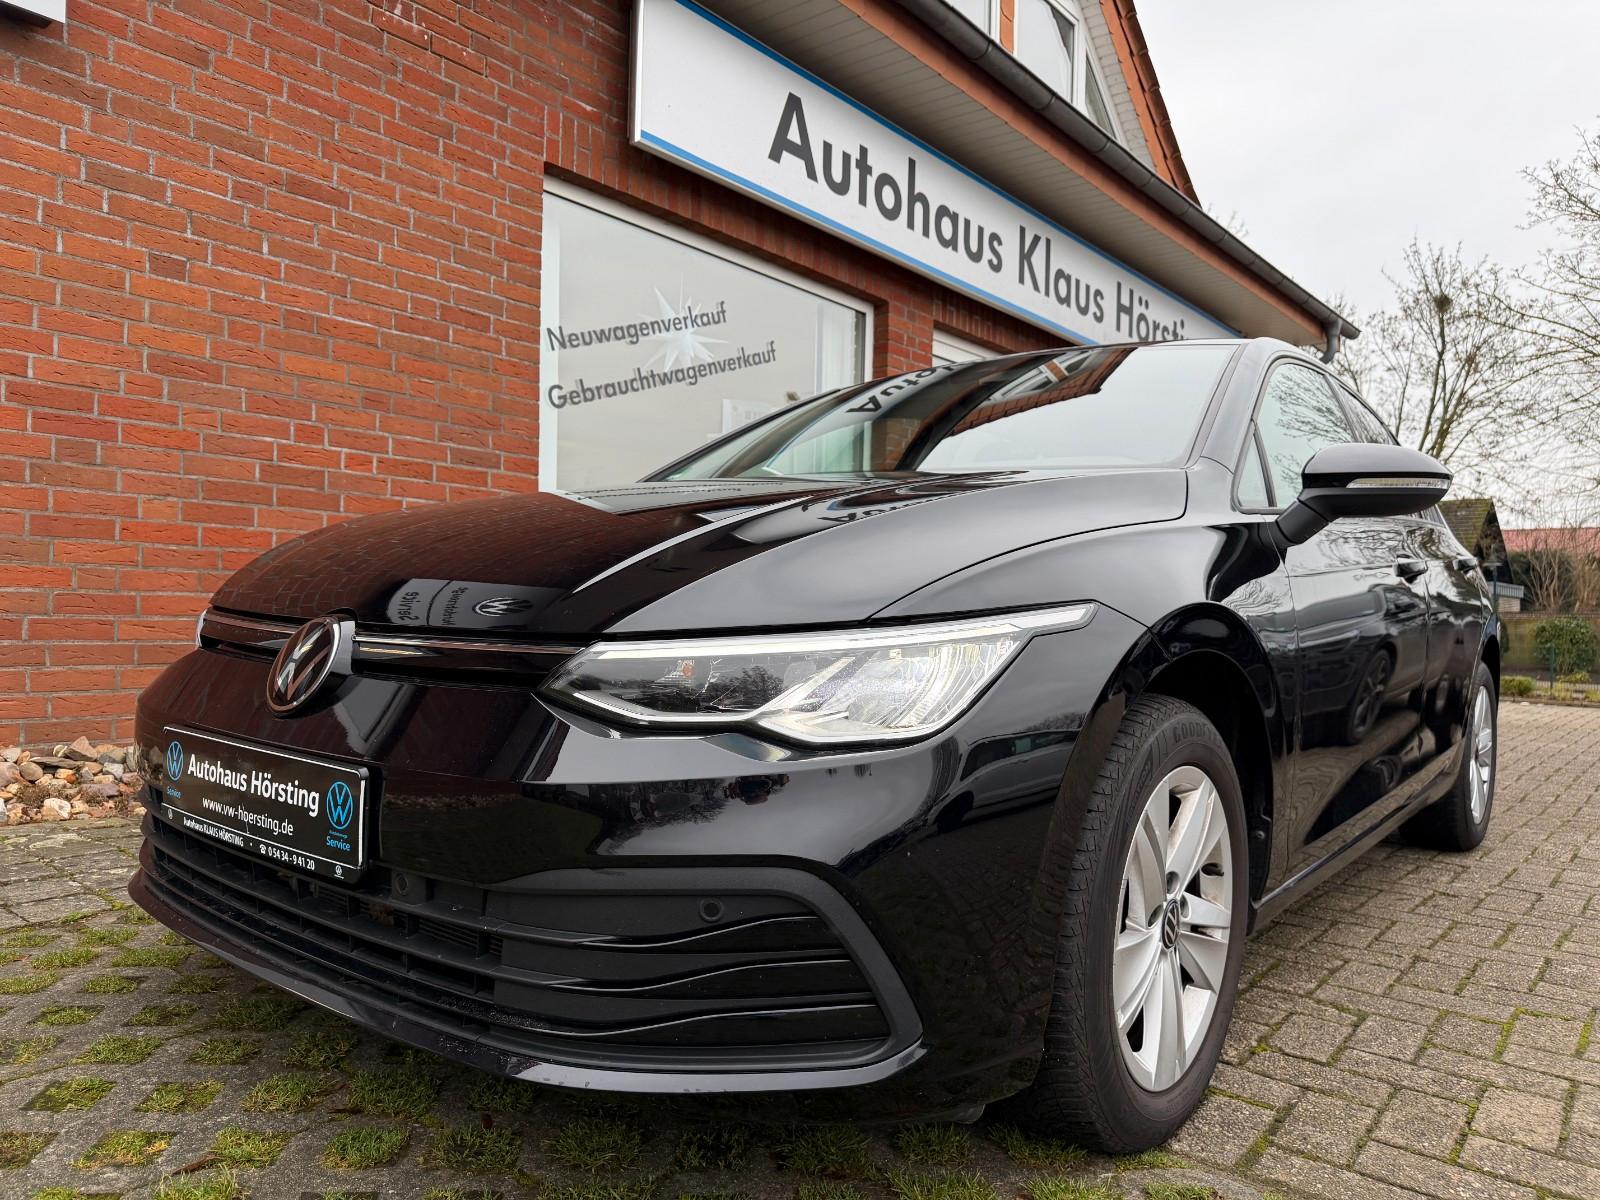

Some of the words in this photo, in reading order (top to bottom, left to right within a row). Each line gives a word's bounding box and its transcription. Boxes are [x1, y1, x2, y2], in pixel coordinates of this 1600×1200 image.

[768, 91, 1003, 273] Autohaus
[1017, 224, 1105, 324] Klaus
[1115, 280, 1188, 342] Hörst
[546, 300, 728, 351] Neuwagenverkauf
[547, 340, 777, 409] Gebrauchtwagenverkauf
[187, 753, 248, 792] Autohaus
[250, 770, 320, 818] Hörsting
[202, 797, 294, 837] www.vw-hoersting.de
[203, 823, 219, 838] KLAUS
[219, 828, 244, 847] HÖRSTING
[326, 835, 351, 852] Service
